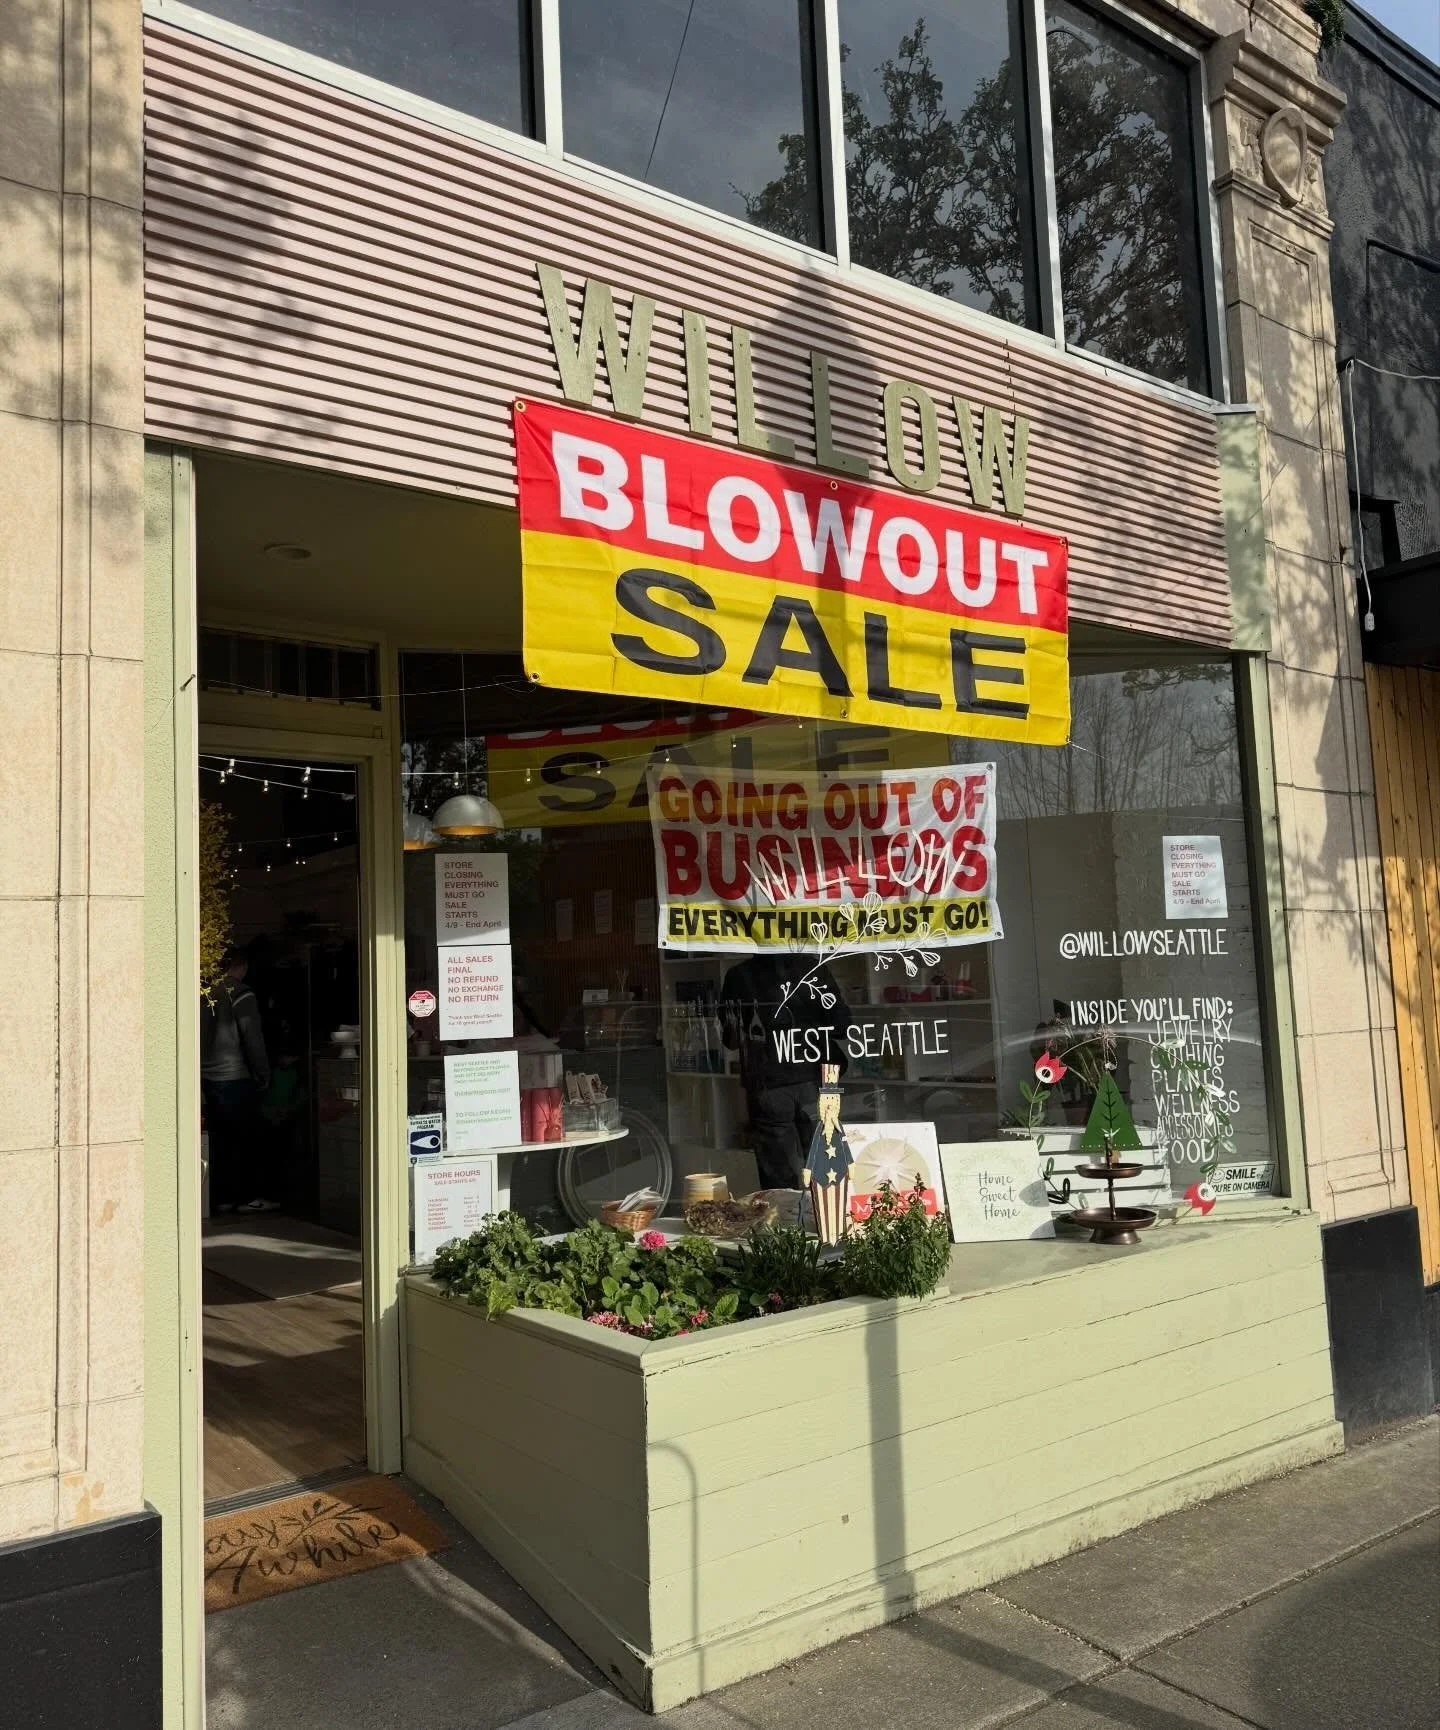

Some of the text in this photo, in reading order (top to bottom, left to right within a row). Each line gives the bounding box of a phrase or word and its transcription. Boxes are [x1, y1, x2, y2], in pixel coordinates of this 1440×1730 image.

[535, 262, 1030, 516] WILLOW
[551, 430, 1049, 614] BLOWOUT
[610, 568, 1030, 720] SALE
[658, 774, 987, 831] GOING OUT OF
[1170, 844, 1196, 852] STORE
[660, 825, 988, 900] BUSINESS
[742, 817, 966, 906] WILLOW
[1170, 853, 1204, 861] CLOSING
[444, 861, 473, 869] STORE
[444, 871, 484, 879] CLOSING
[444, 880, 499, 889] EVERYTHING
[1172, 880, 1192, 888] SALE
[445, 891, 470, 899] MUST
[444, 901, 467, 909] SALE
[444, 911, 478, 919] STARTS
[669, 901, 989, 940] EVERYTHING MUST GO!
[483, 920, 502, 929] April
[1059, 928, 1229, 959] @WILLOWSEATTLE
[447, 955, 493, 964] ALL SALES
[447, 966, 473, 974] FINAL
[447, 975, 499, 984] NO REFUND
[461, 985, 504, 993] EXCHANGE
[463, 994, 499, 1003] RETURN
[1071, 996, 1234, 1026] INSIDE YOU'LL FIND:
[772, 1019, 950, 1064] WEST SEATTLE
[1150, 1043, 1225, 1069] COTHING
[427, 1169, 481, 1180] STORE HOURS
[1225, 1167, 1257, 1180] SMILE
[978, 1172, 1014, 1187] Home
[1232, 1182, 1243, 1191] ON
[1243, 1180, 1270, 1191] CAMERA
[979, 1187, 1018, 1202] Sweet
[984, 1203, 1021, 1218] Home
